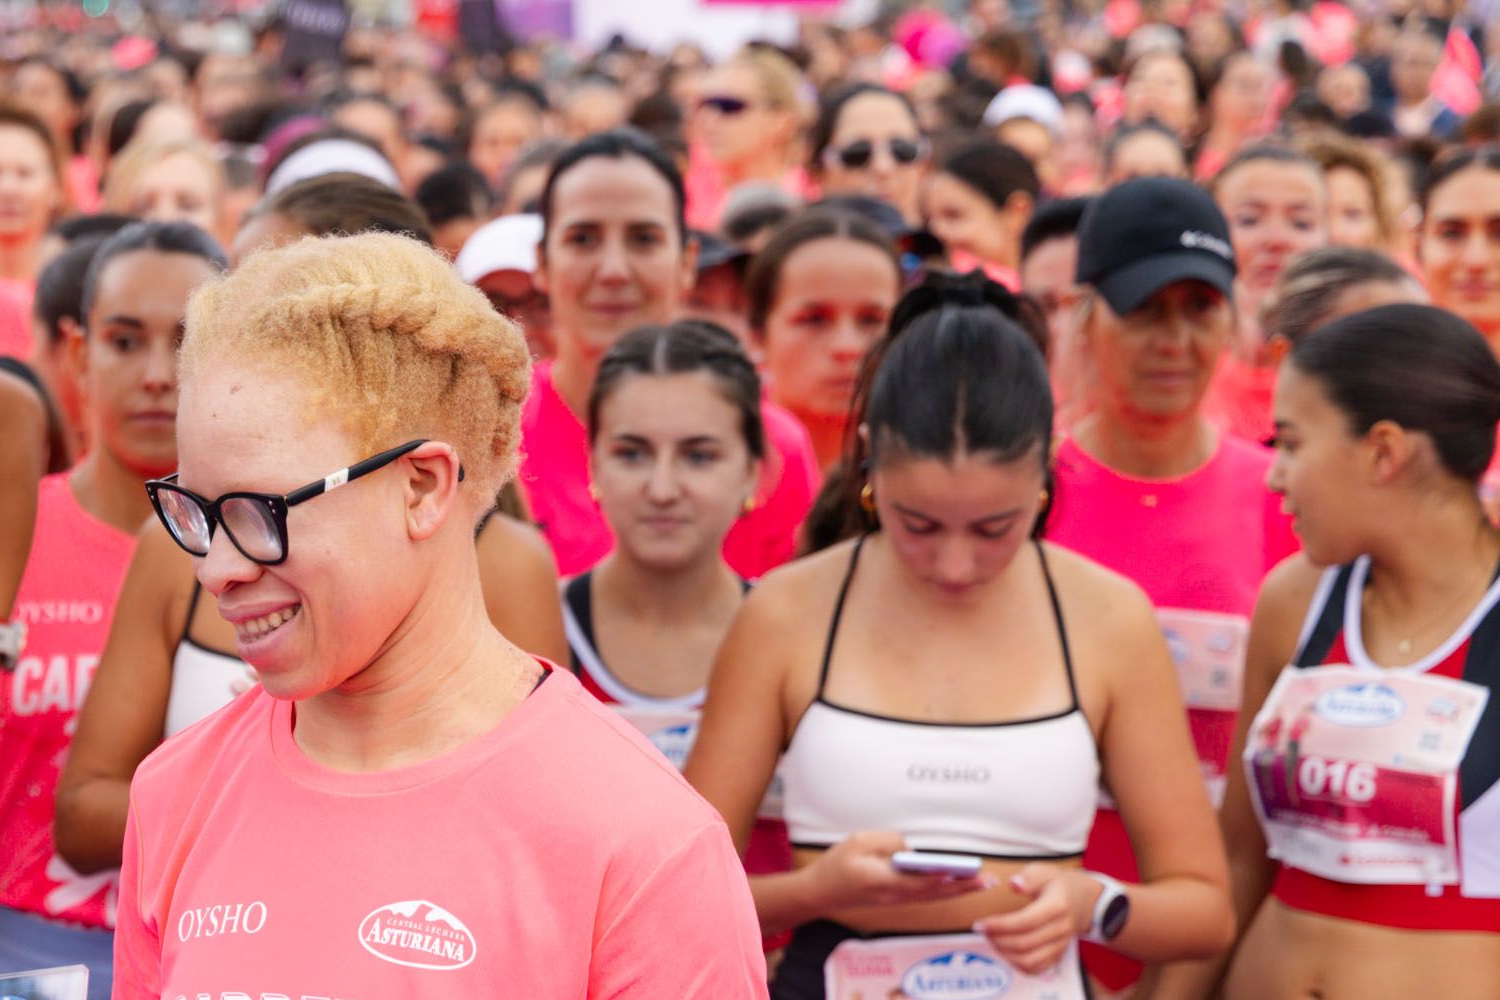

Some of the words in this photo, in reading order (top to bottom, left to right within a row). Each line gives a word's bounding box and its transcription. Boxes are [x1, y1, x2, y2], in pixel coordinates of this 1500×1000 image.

[20, 602, 102, 623] YSHO
[905, 762, 992, 783] OYSHO
[1299, 756, 1378, 802] 016
[178, 901, 268, 942] OYSHO
[386, 917, 423, 931] CENTRAL
[425, 924, 466, 942] LECHERA
[365, 917, 465, 962] ASTURIANA
